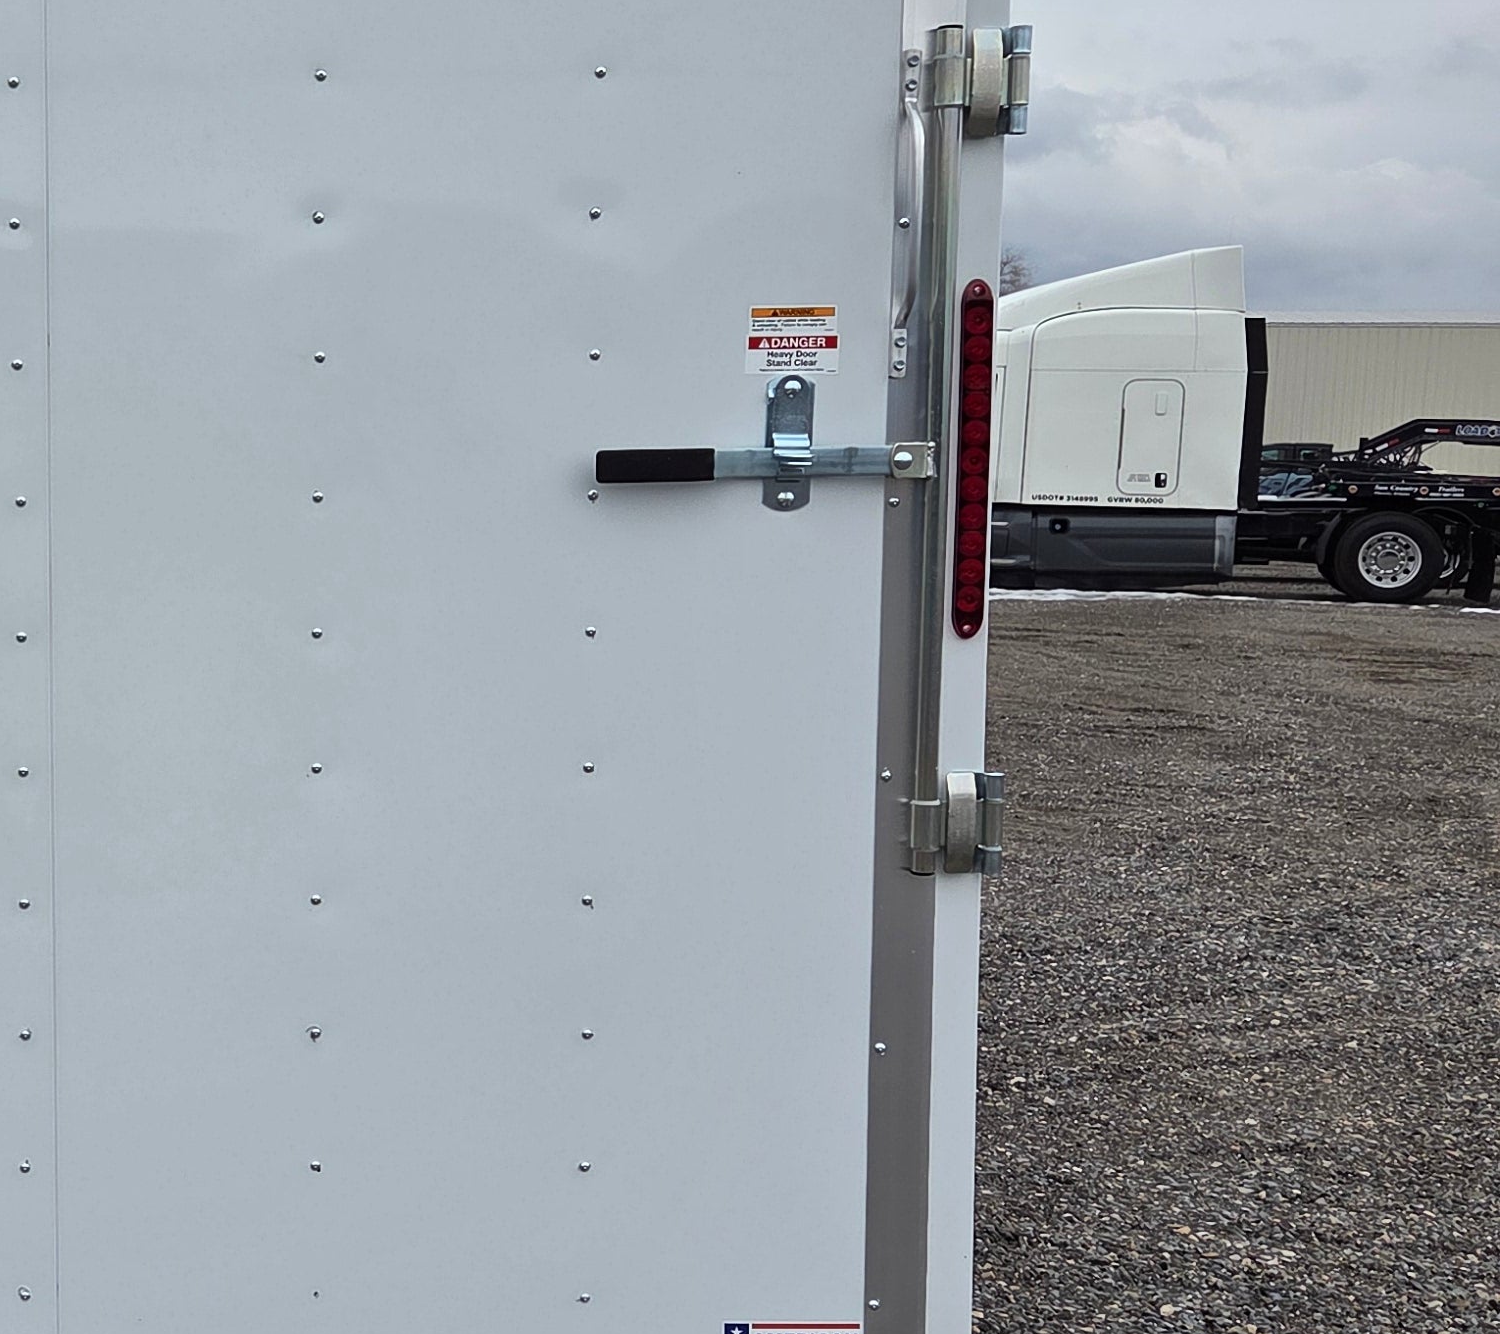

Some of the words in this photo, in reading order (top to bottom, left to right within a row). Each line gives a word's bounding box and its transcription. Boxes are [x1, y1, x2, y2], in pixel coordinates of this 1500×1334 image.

[779, 308, 815, 316] WARNING
[771, 337, 826, 348] DANGER
[767, 350, 793, 359] Heavy
[795, 350, 818, 358] Door
[766, 359, 791, 367] Stand
[793, 359, 818, 367] Clear
[1455, 424, 1488, 436] LOAD
